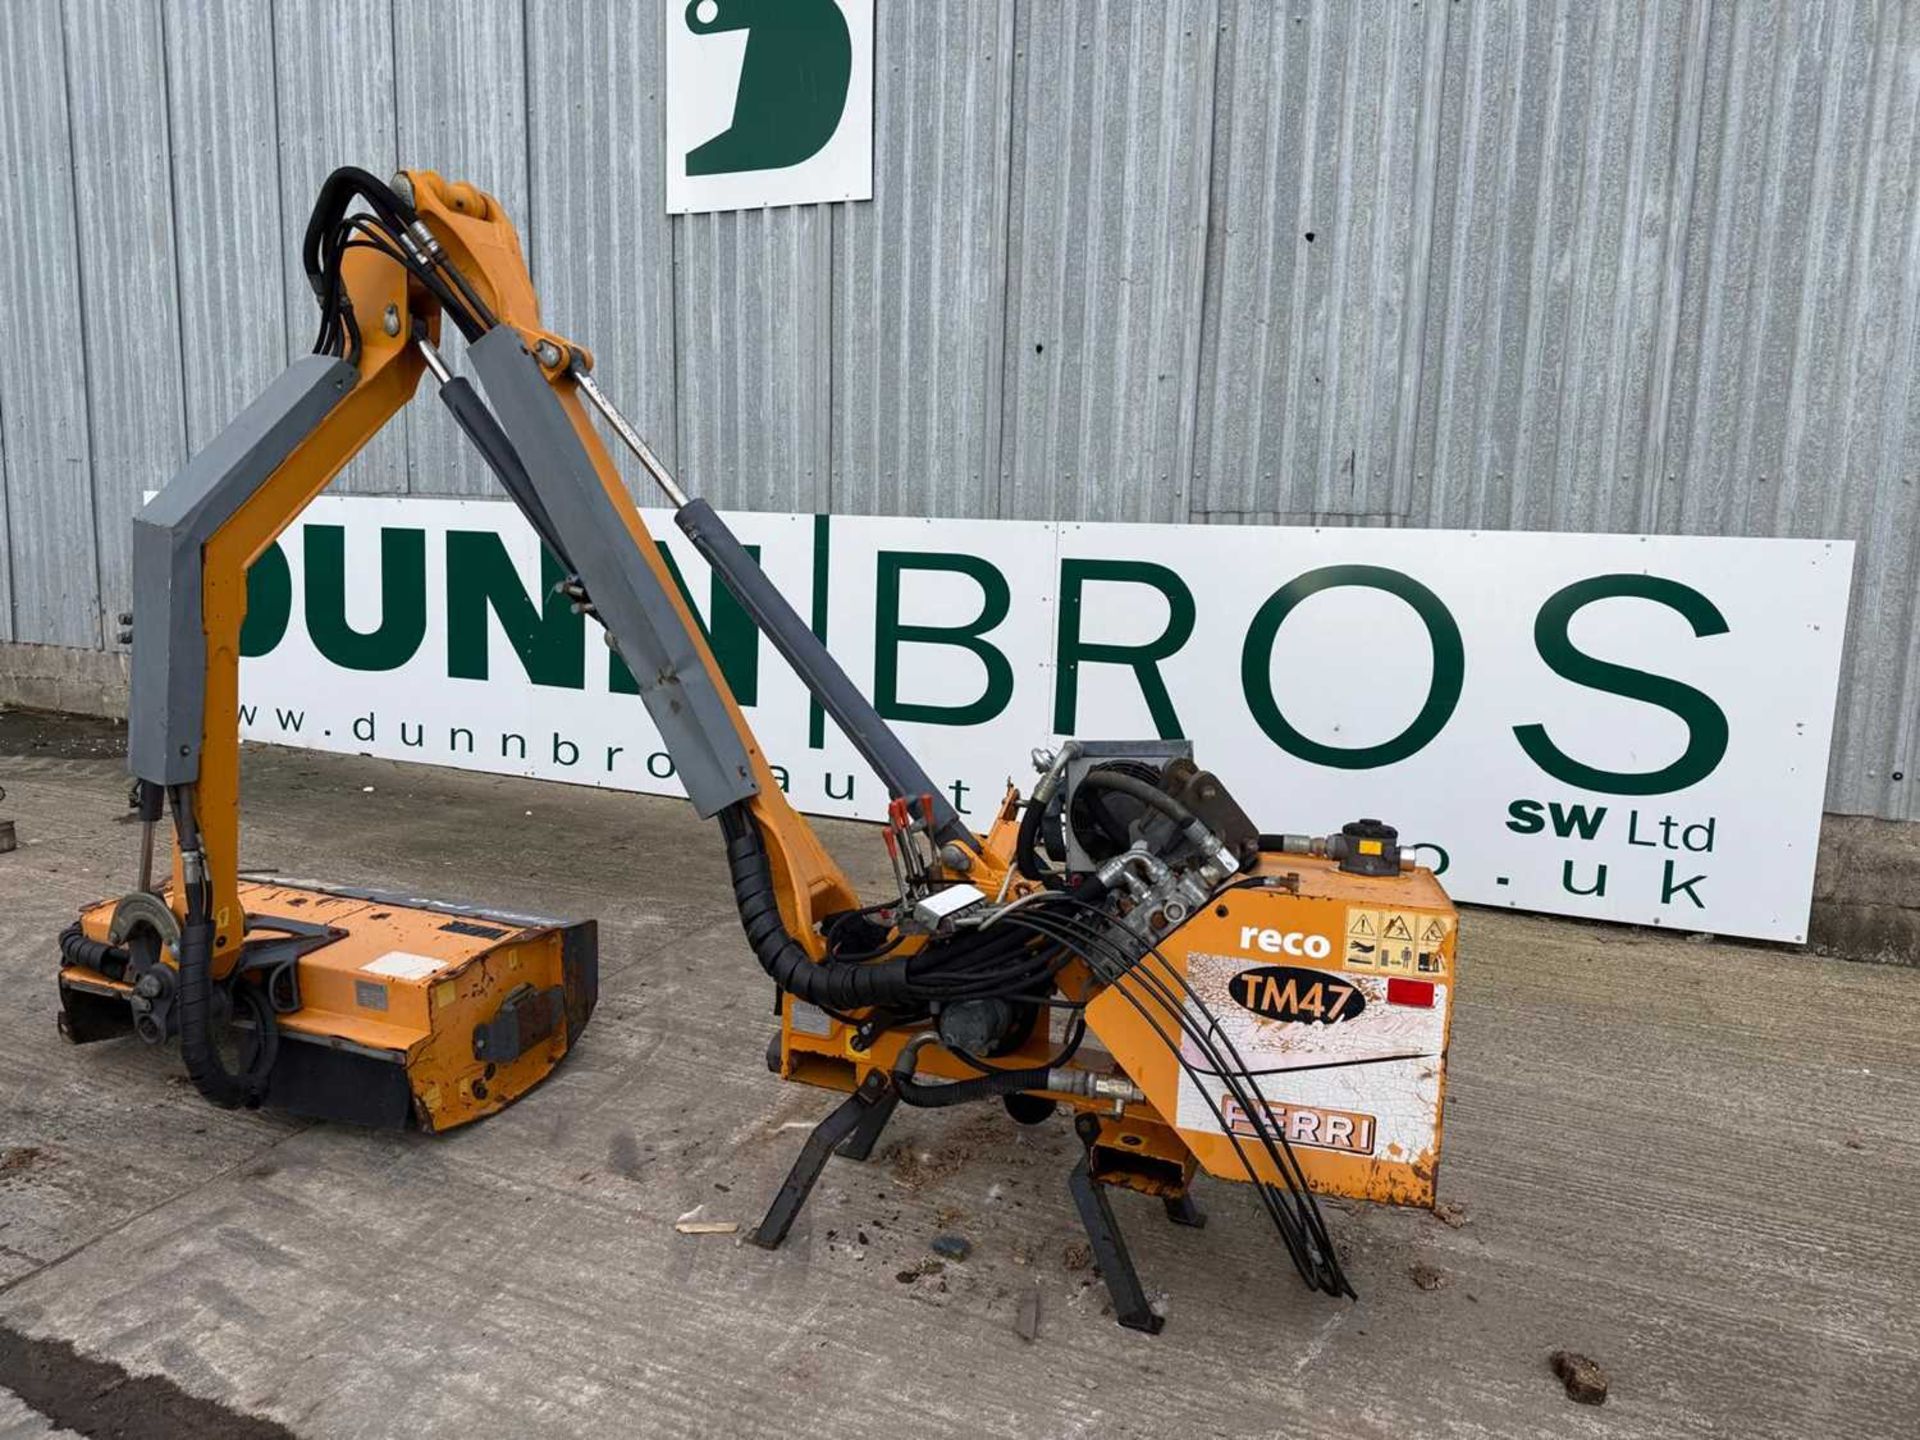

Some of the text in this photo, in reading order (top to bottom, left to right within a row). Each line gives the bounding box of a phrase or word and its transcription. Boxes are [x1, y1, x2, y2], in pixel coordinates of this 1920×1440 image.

[869, 550, 1729, 796] BROS
[1627, 809, 1716, 853] Ltd
[1239, 925, 1332, 959] reco
[1240, 973, 1355, 1022] TM47
